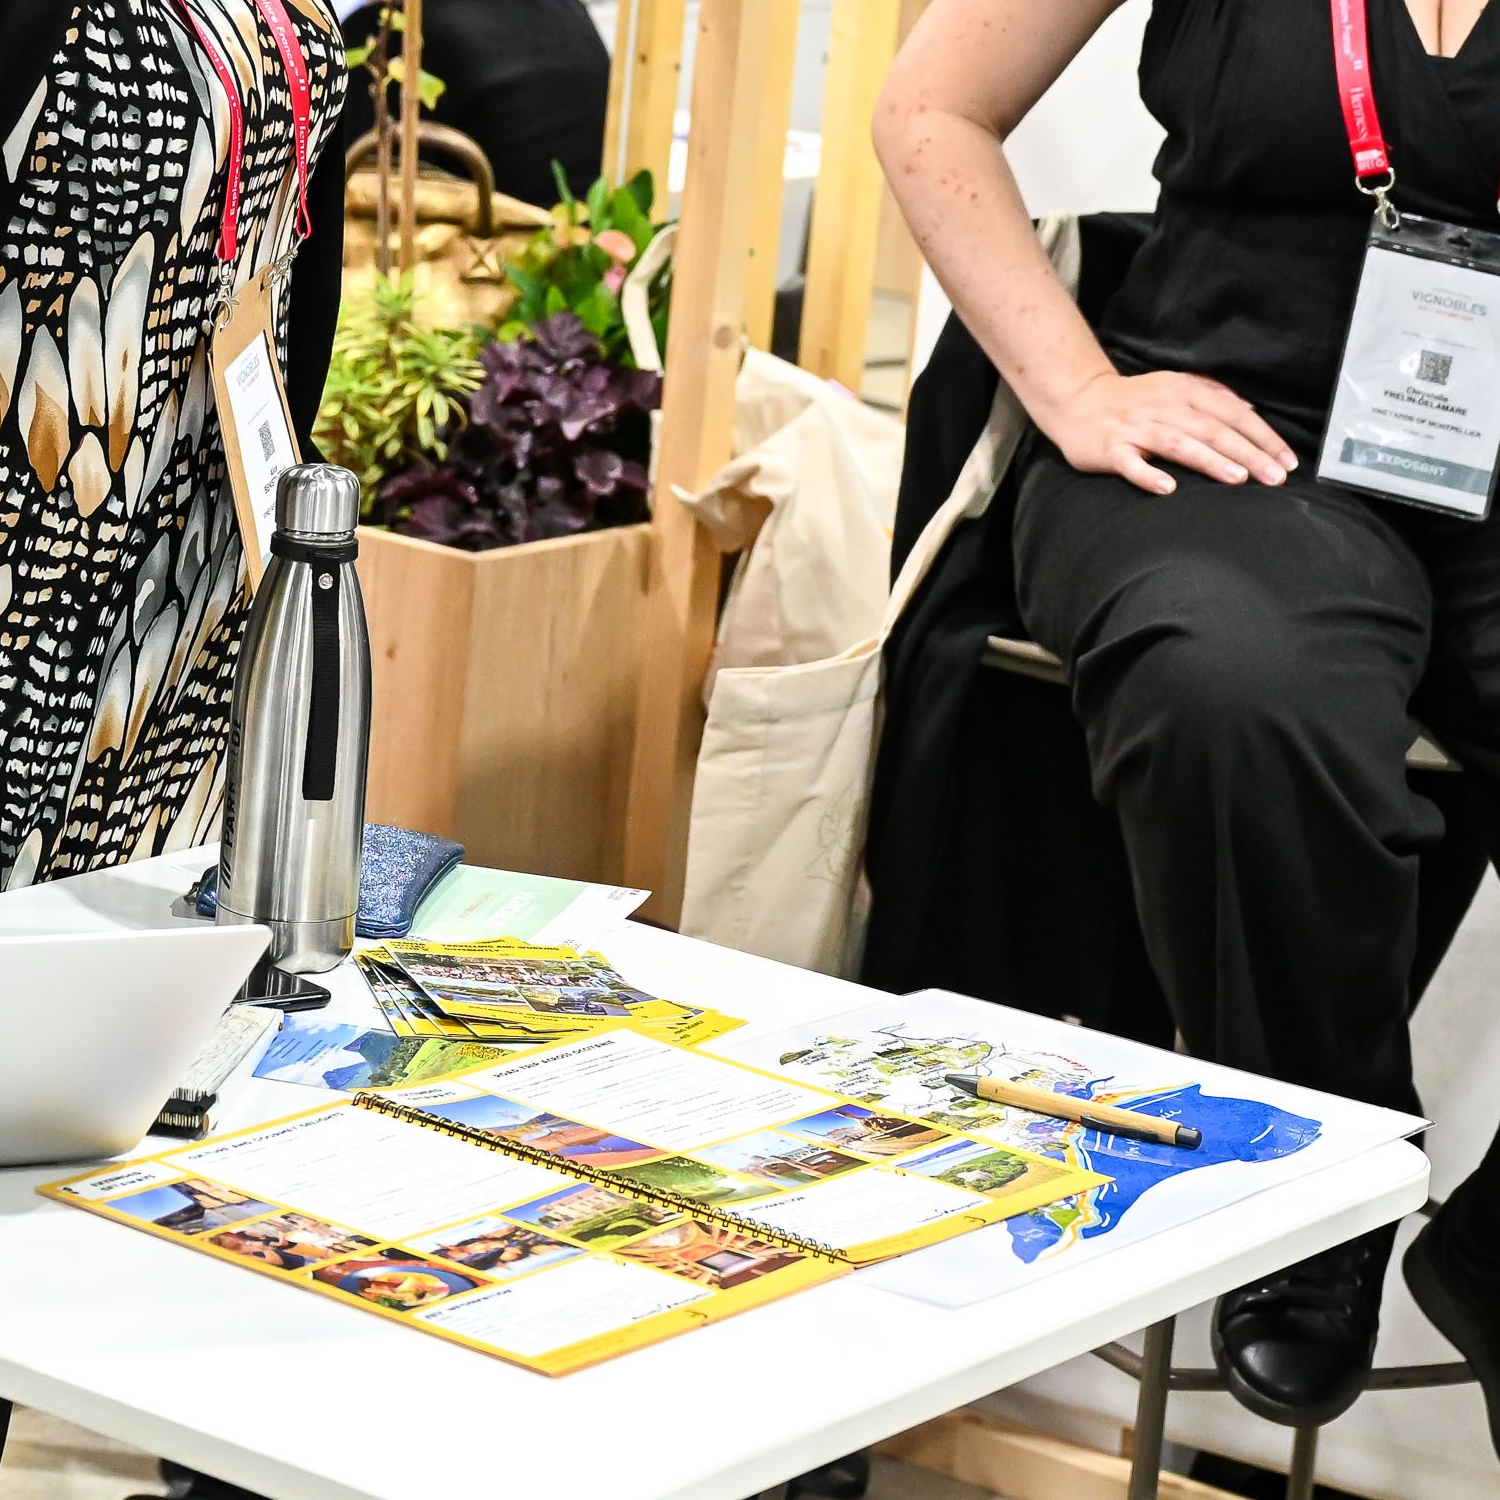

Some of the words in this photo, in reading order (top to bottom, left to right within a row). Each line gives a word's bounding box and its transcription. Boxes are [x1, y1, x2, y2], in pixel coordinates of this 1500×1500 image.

[1411, 289, 1488, 317] VIGNOBLES
[492, 1067, 520, 1079] ROAD
[521, 1061, 541, 1070] TRIP
[542, 1051, 573, 1064] ACROSS
[573, 1039, 617, 1054] OCCITANIE
